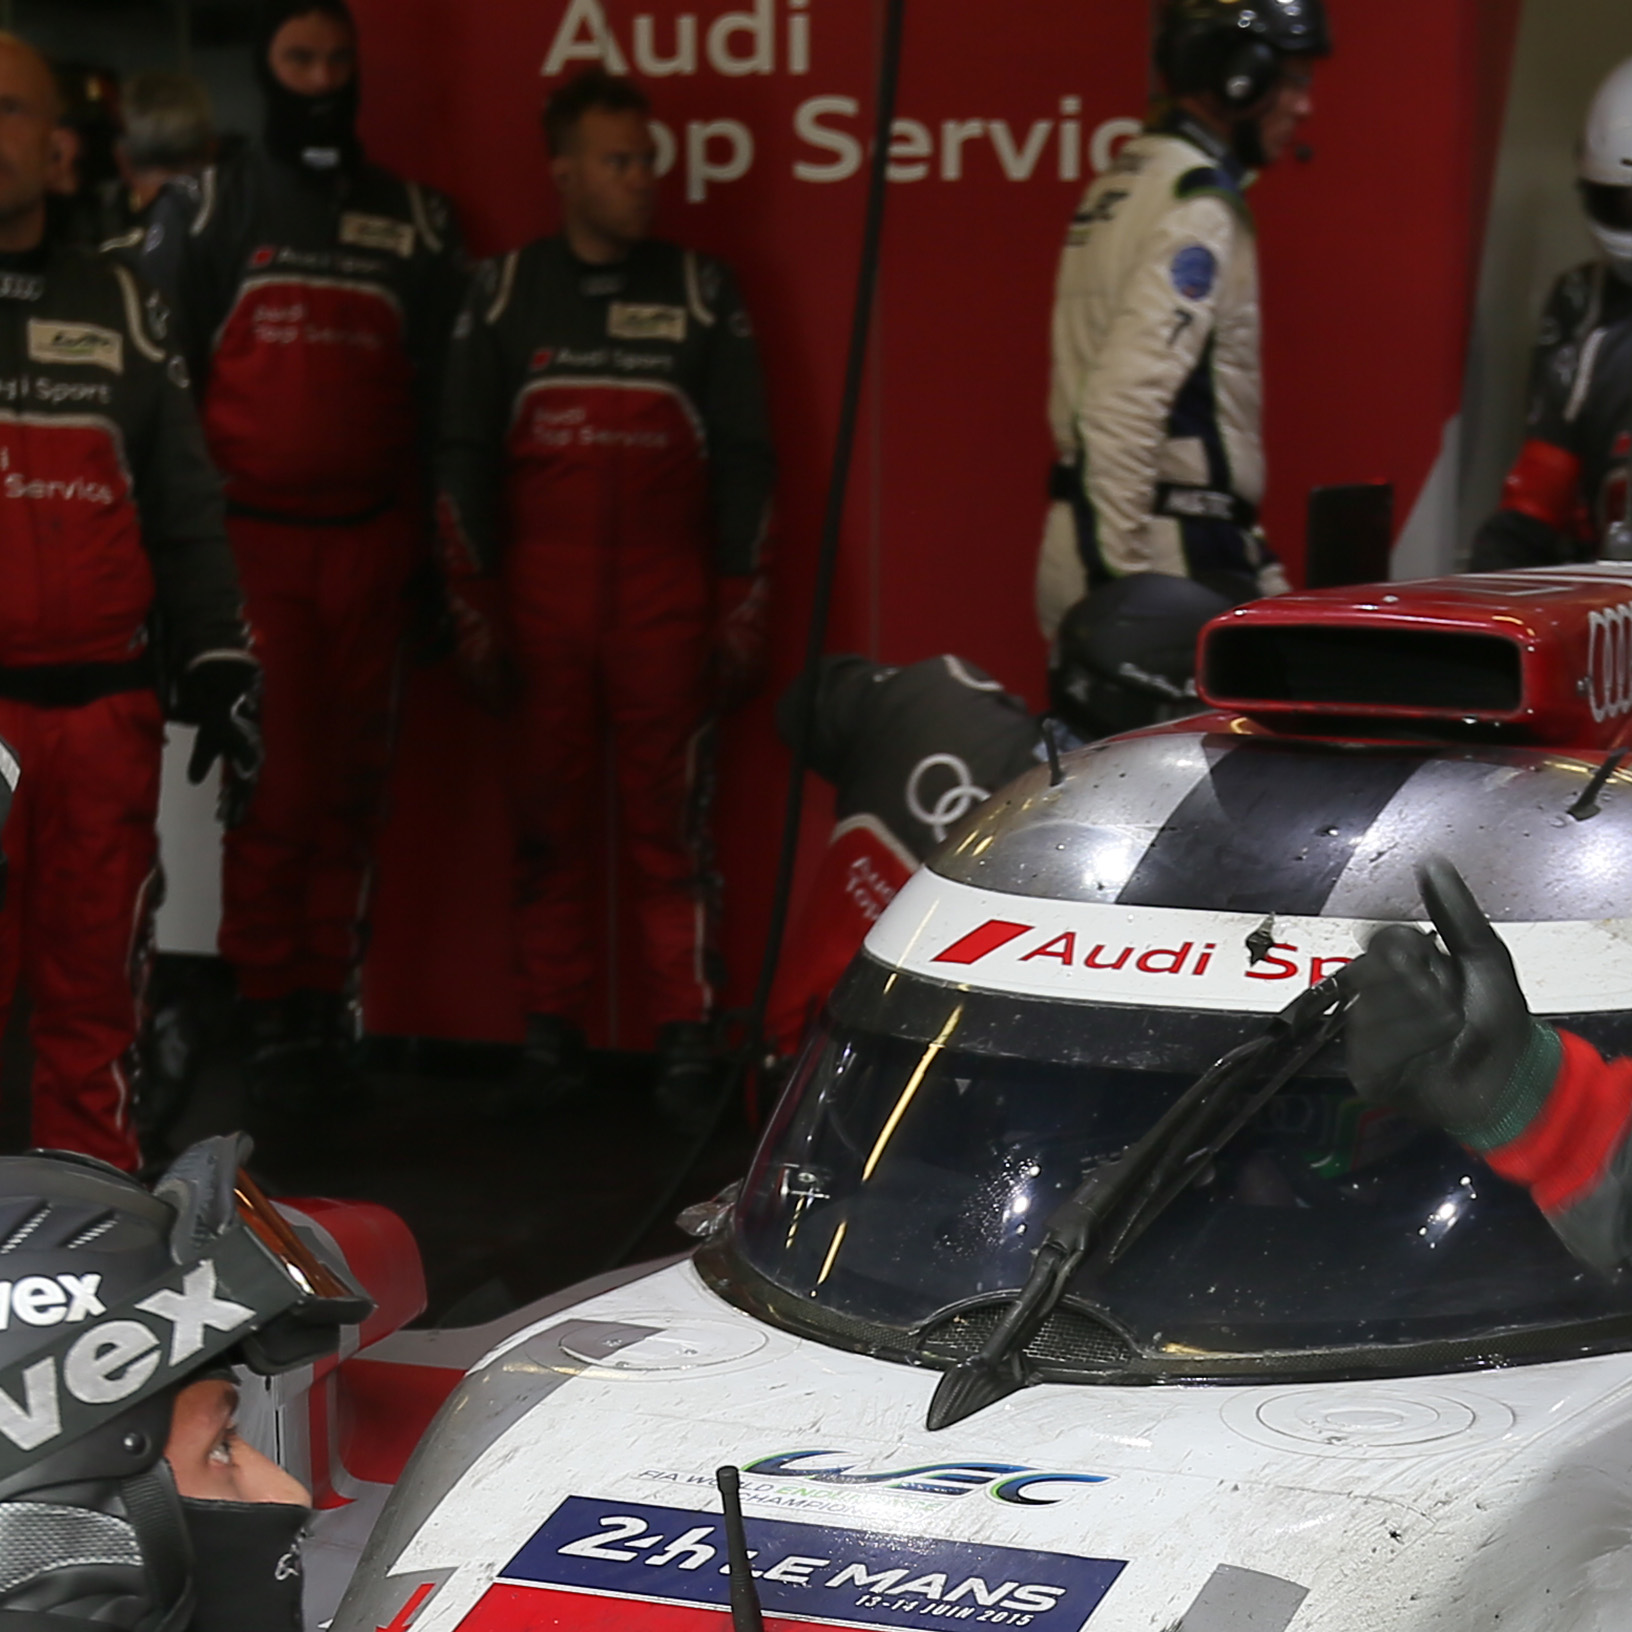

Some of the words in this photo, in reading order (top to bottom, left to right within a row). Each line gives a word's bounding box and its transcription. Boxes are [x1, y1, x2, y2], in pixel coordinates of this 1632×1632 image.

[540, 0, 811, 77] Audi
[645, 116, 755, 204] op
[791, 94, 1145, 183] Servic
[1018, 931, 1217, 976] Audi
[684, 1474, 775, 1494] WOLD
[824, 1563, 1067, 1614] MANS
[854, 1593, 918, 1615] 13-14
[919, 1600, 977, 1621] JUIN
[976, 1605, 1036, 1627] 2015
